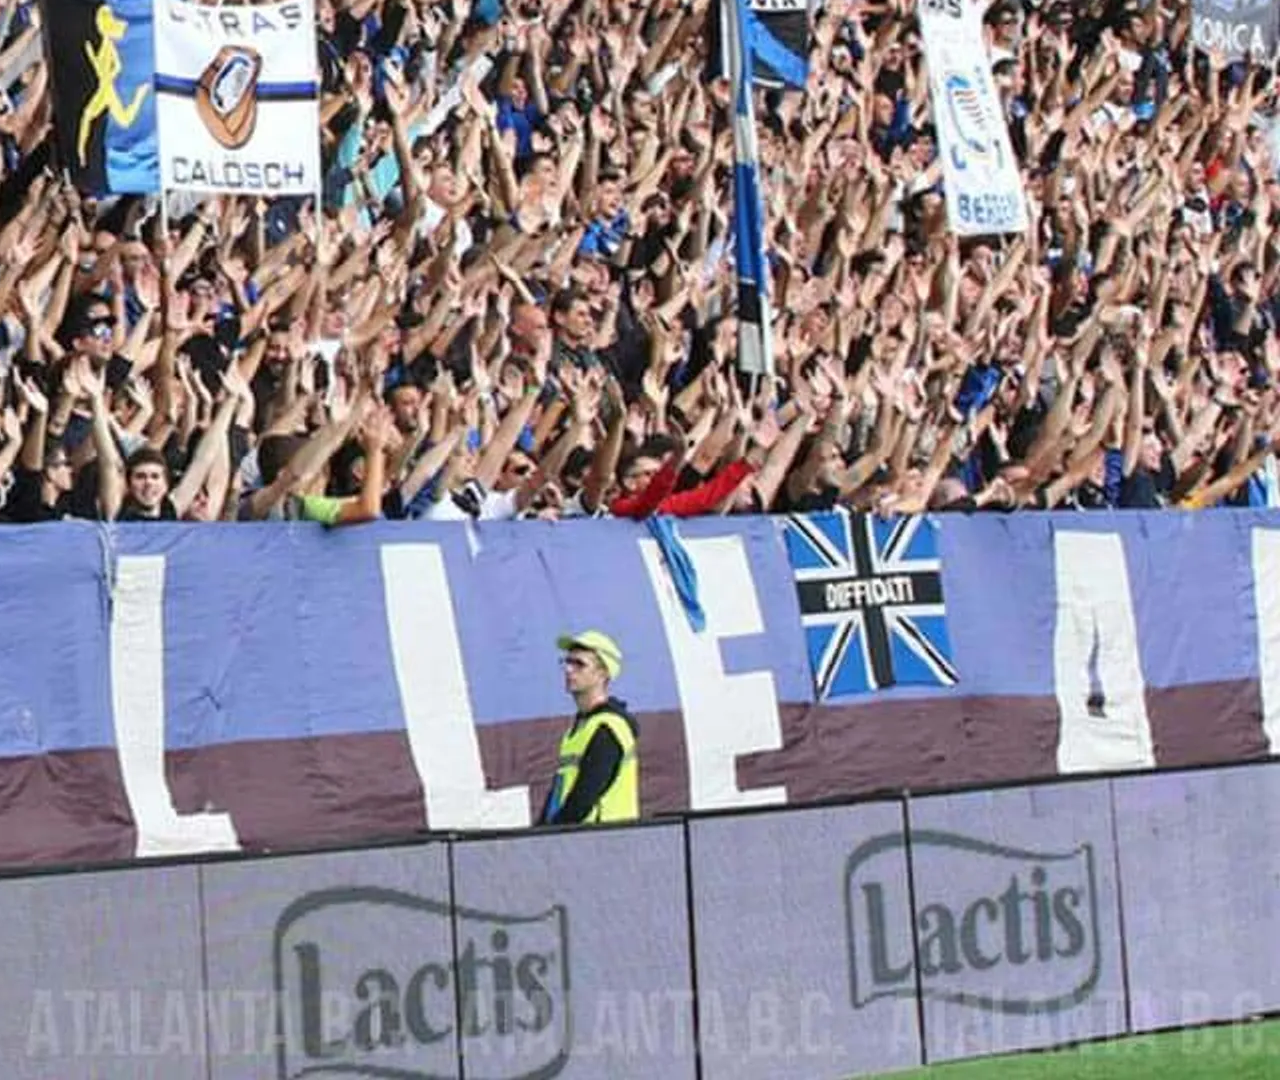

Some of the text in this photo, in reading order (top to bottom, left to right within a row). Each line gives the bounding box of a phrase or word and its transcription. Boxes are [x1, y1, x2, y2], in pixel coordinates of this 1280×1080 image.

[825, 576, 915, 610] DIFFIDATI
[860, 865, 1087, 987] Lactis
[293, 927, 556, 1059] Lactis
